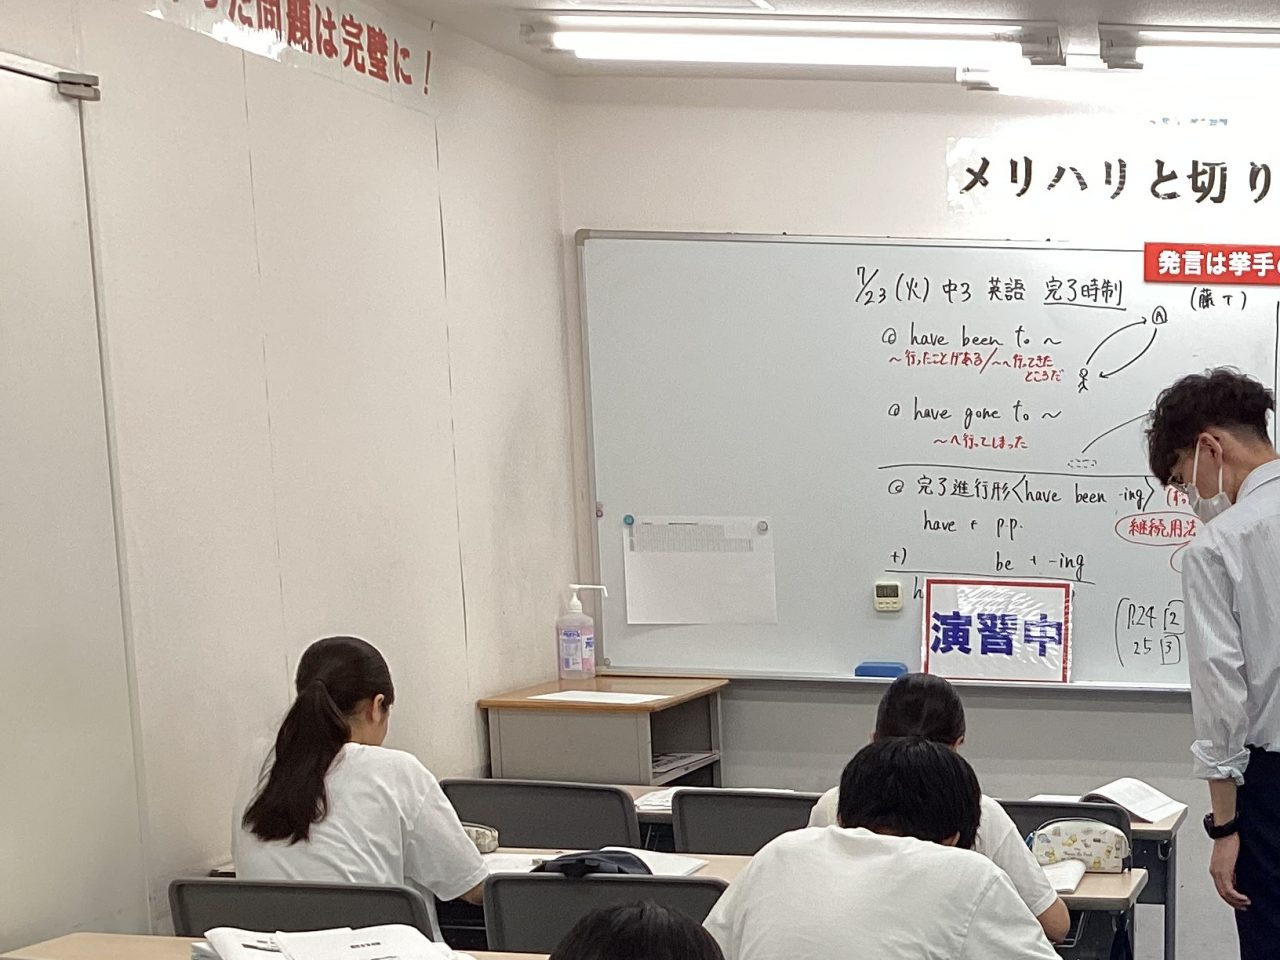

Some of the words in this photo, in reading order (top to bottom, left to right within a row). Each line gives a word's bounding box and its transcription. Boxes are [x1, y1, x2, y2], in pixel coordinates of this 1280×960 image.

[896, 272, 930, 302] (火)
[942, 279, 971, 304] 中3
[988, 276, 1026, 301] 英語
[1044, 275, 1122, 306] 完了時制
[911, 321, 949, 346] have
[962, 325, 1003, 346] been
[1015, 325, 1030, 348] to
[1025, 369, 1064, 382] ところだ
[914, 396, 952, 421] have
[964, 407, 1001, 430] gone
[1013, 400, 1030, 422] to
[1075, 482, 1107, 502] been
[924, 510, 957, 532] have
[1129, 518, 1196, 538] 継続用法
[996, 552, 1013, 571] be
[931, 611, 1063, 657] 演習中
